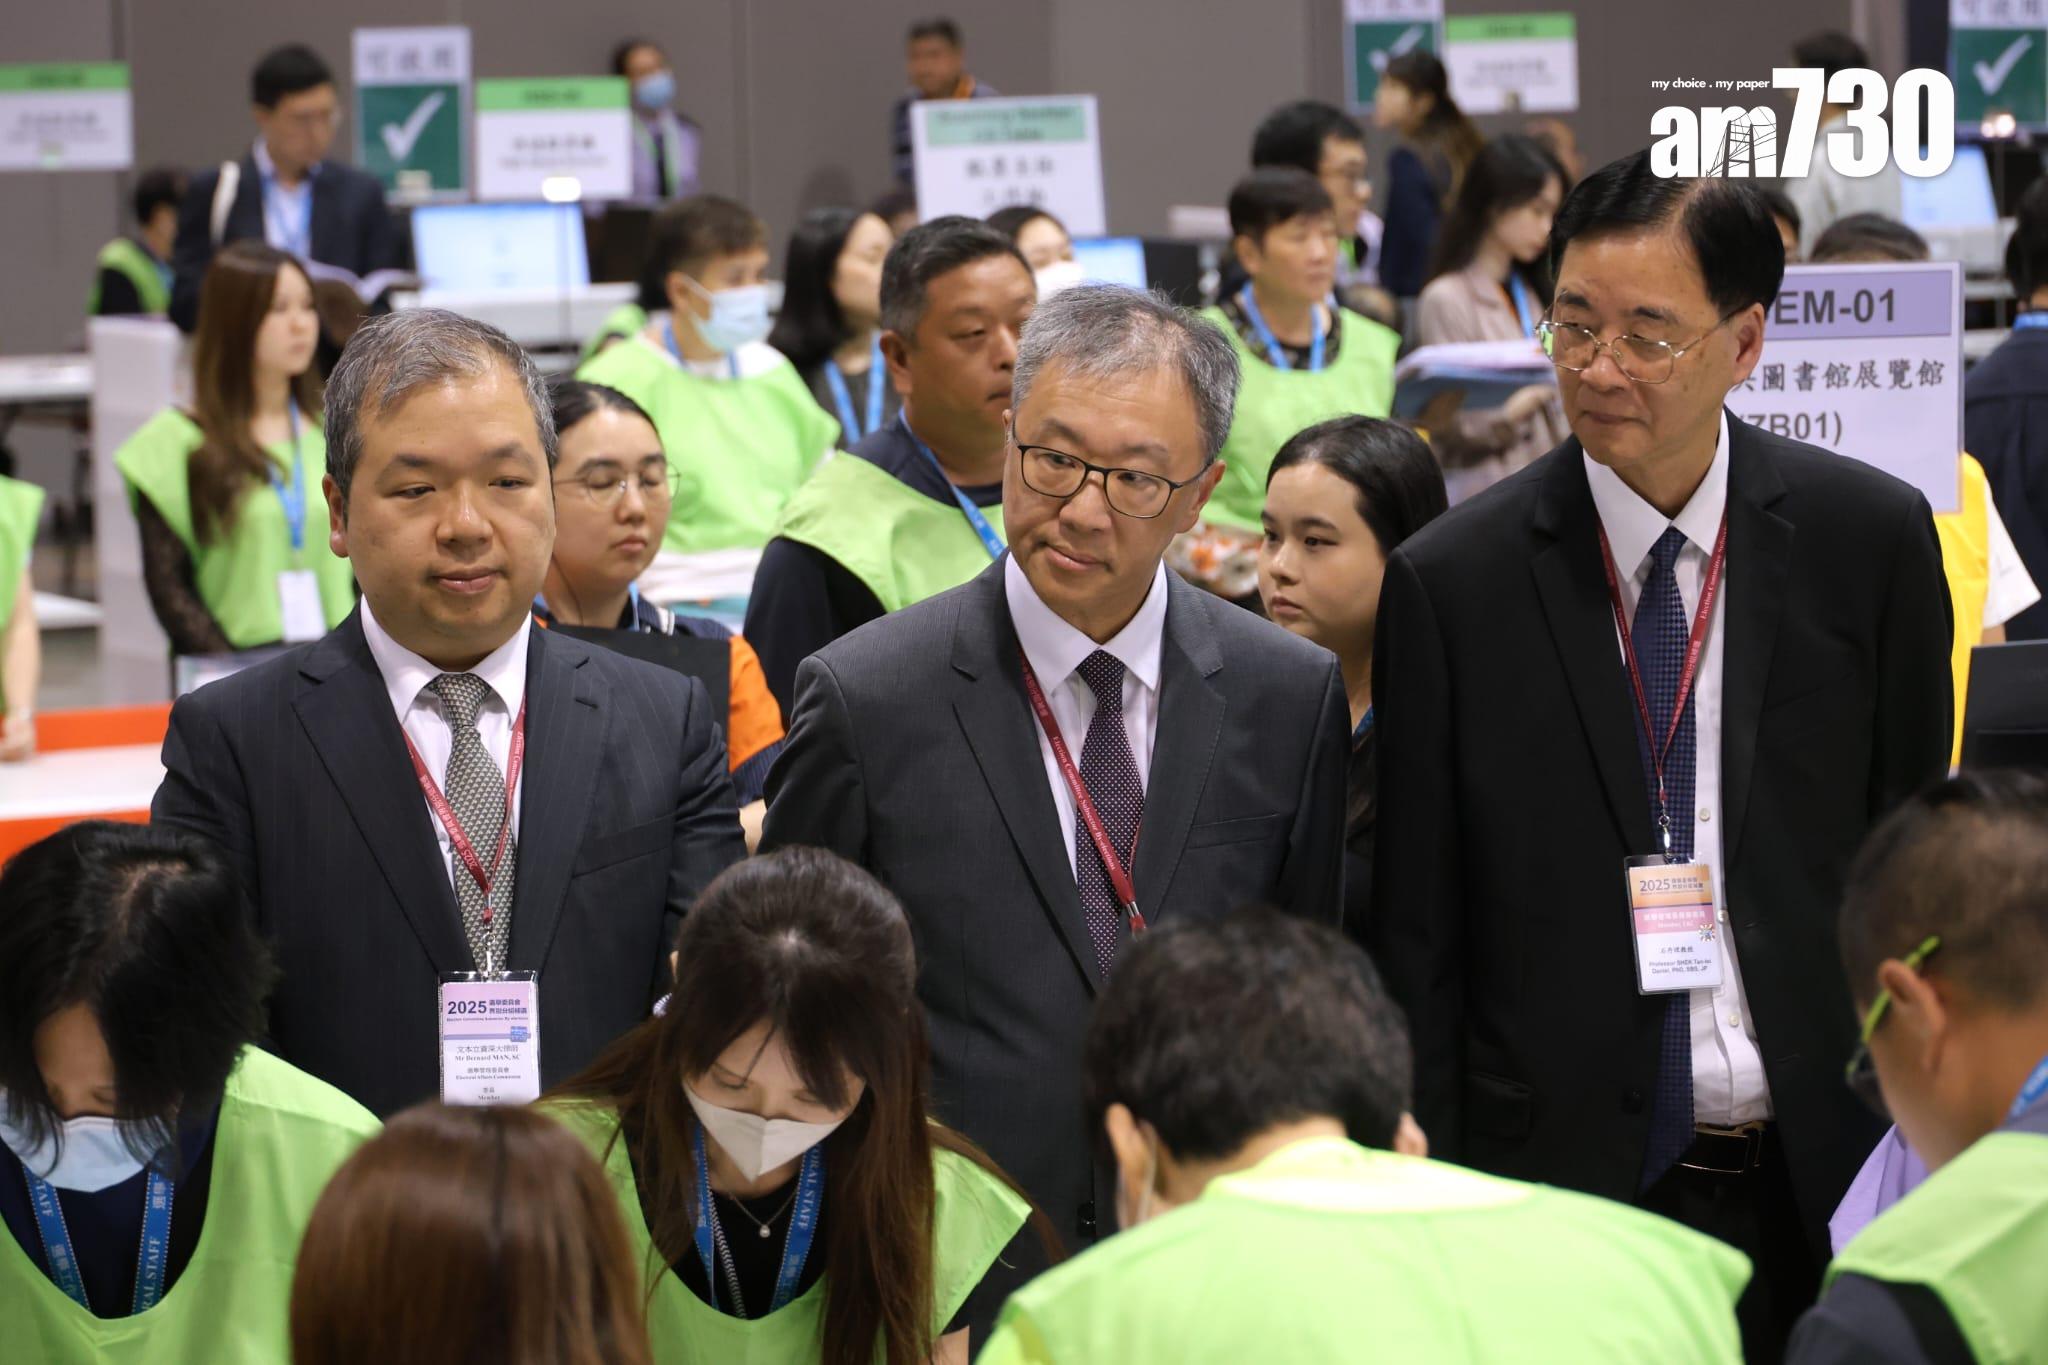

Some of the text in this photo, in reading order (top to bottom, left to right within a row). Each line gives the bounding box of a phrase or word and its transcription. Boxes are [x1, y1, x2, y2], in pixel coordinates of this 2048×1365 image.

[1774, 288, 1894, 324] EM-01
[1740, 411, 1842, 446] ZB01)
[1700, 592, 1712, 619] Election
[1709, 555, 1721, 590] Committee
[1053, 736, 1117, 870] Election Committee Subsector By-elections
[461, 848, 478, 868] 2025
[1639, 879, 1671, 892] 2025
[448, 1000, 487, 1015] 2025
[35, 1179, 54, 1217] TAFF
[798, 1189, 814, 1229] STAFF
[147, 1236, 160, 1279] STAFF
